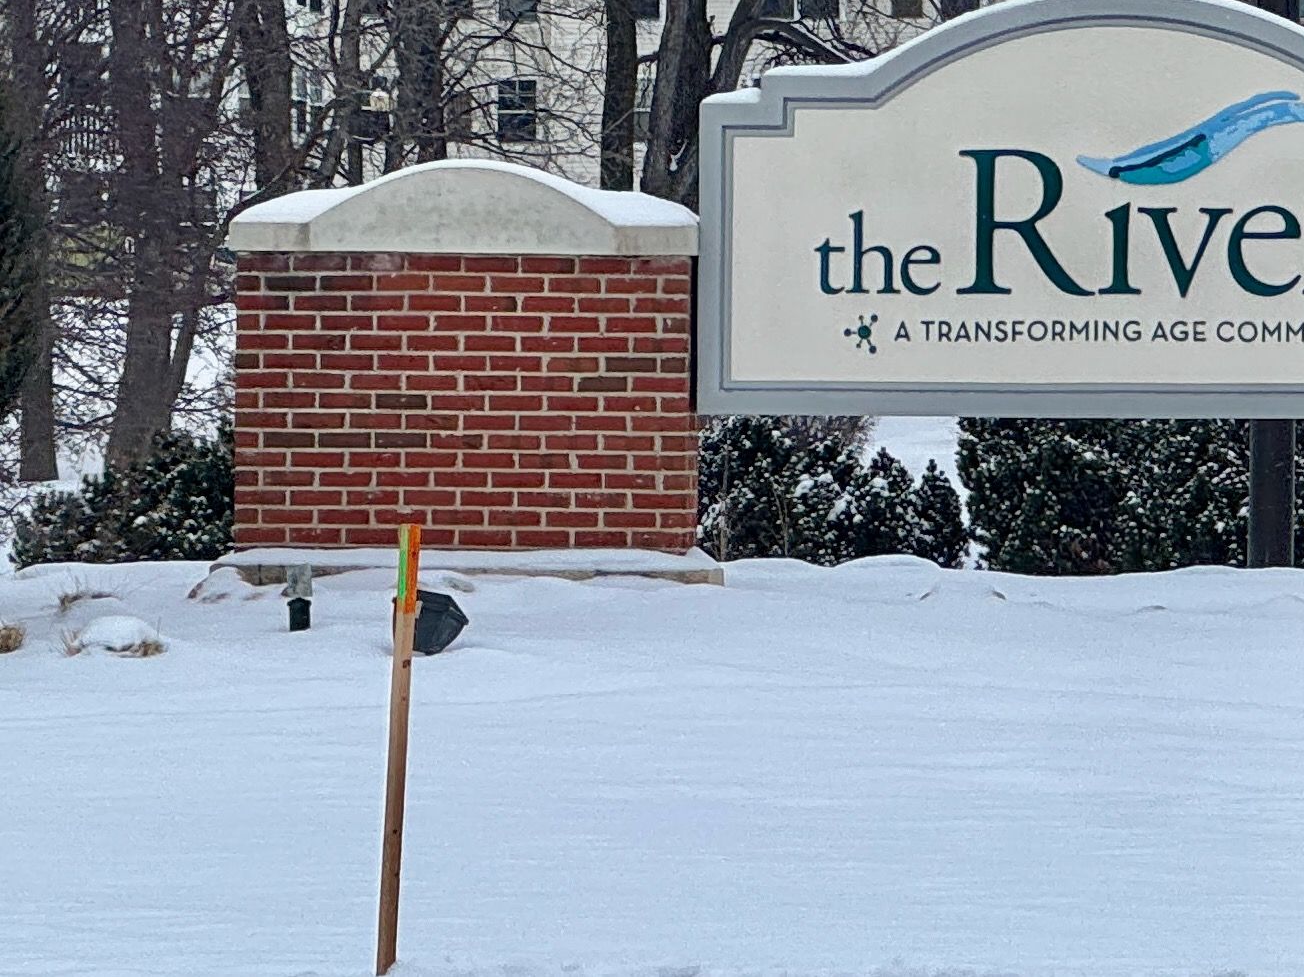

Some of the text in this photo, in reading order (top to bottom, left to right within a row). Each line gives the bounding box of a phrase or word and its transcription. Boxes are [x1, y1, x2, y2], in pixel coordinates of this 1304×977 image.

[815, 210, 941, 295] the
[894, 320, 911, 342] A
[921, 321, 1142, 343] TRANSFORMING
[1151, 322, 1207, 343] AGE
